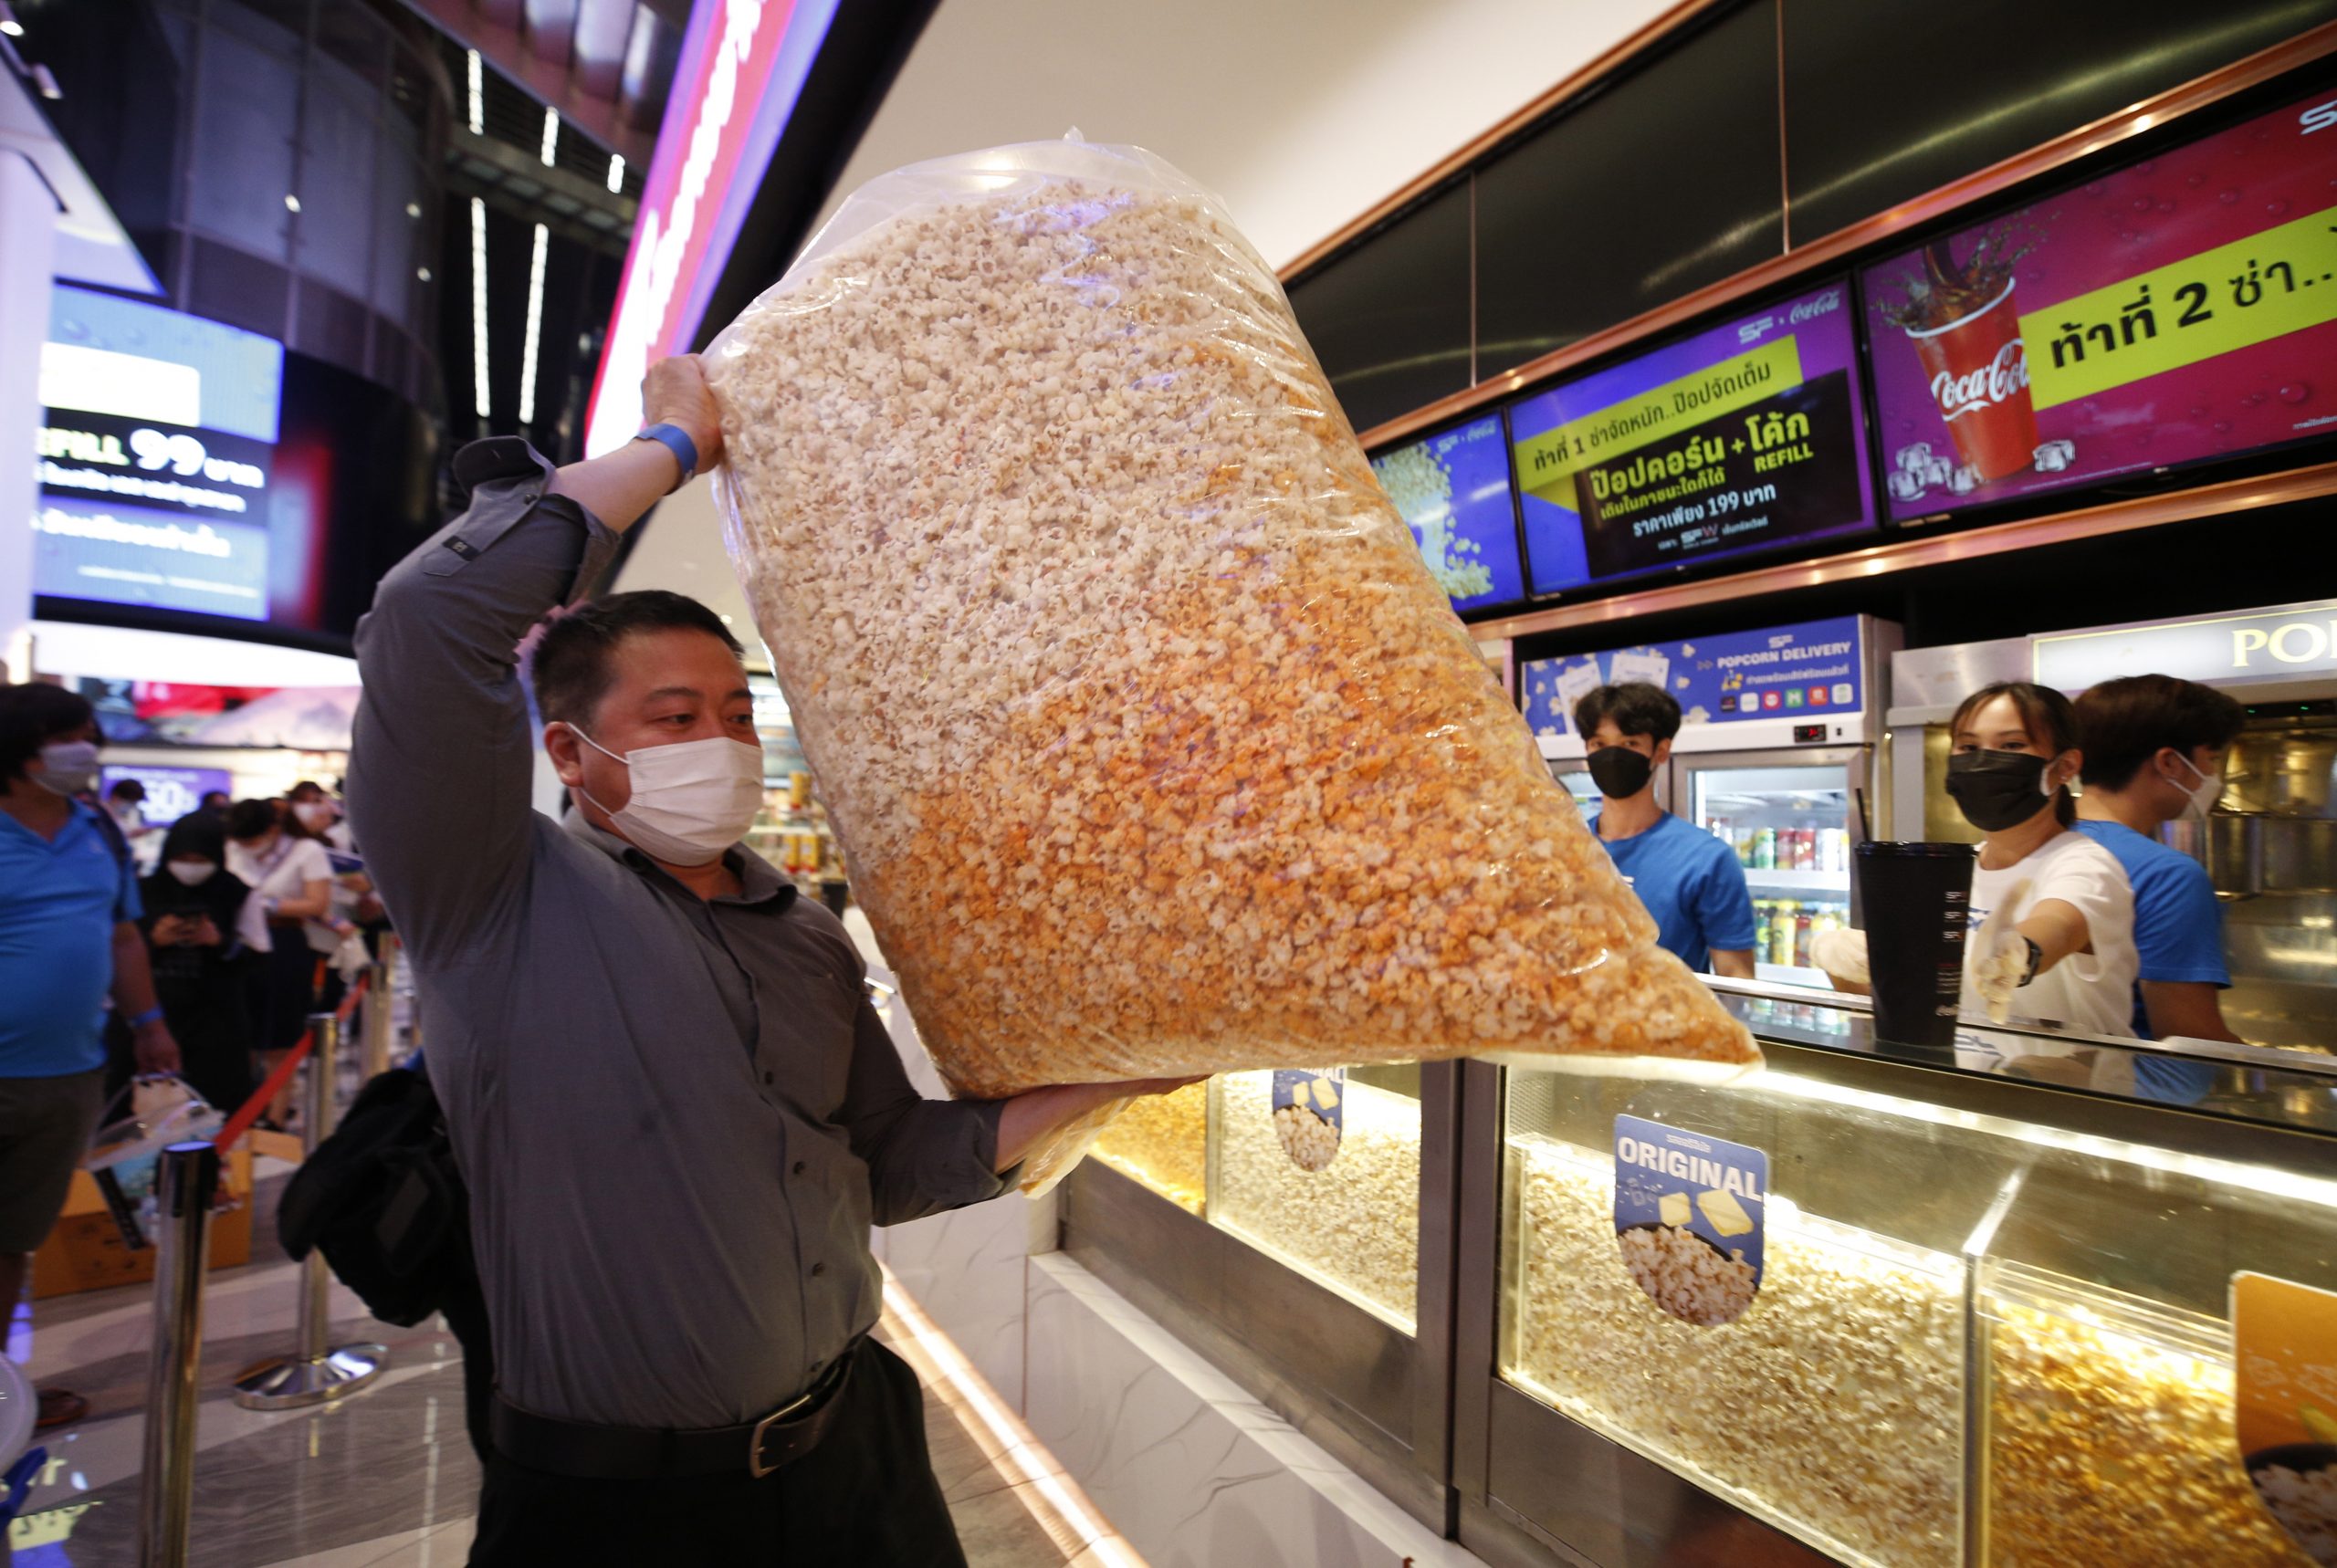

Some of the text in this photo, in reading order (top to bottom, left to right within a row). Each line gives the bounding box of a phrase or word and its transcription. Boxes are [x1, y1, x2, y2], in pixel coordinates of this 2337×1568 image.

[2299, 99, 2337, 135] S
[2050, 285, 2157, 369] ท้าที่
[2174, 281, 2213, 328] 2
[1931, 338, 2030, 409] Coca-Col
[130, 428, 207, 476] 99
[1574, 437, 1585, 455] 1
[1590, 434, 1725, 500] ป๊อปคอร์น
[1745, 411, 1811, 453] โค้ก
[1754, 443, 1814, 474] REFILL
[1707, 491, 1740, 517] 199
[1743, 483, 1777, 507] บาท
[1717, 642, 1851, 669] POPCORN DELIVERY
[2232, 619, 2337, 668] PO
[1618, 1136, 1764, 1203] ORIGINAL
